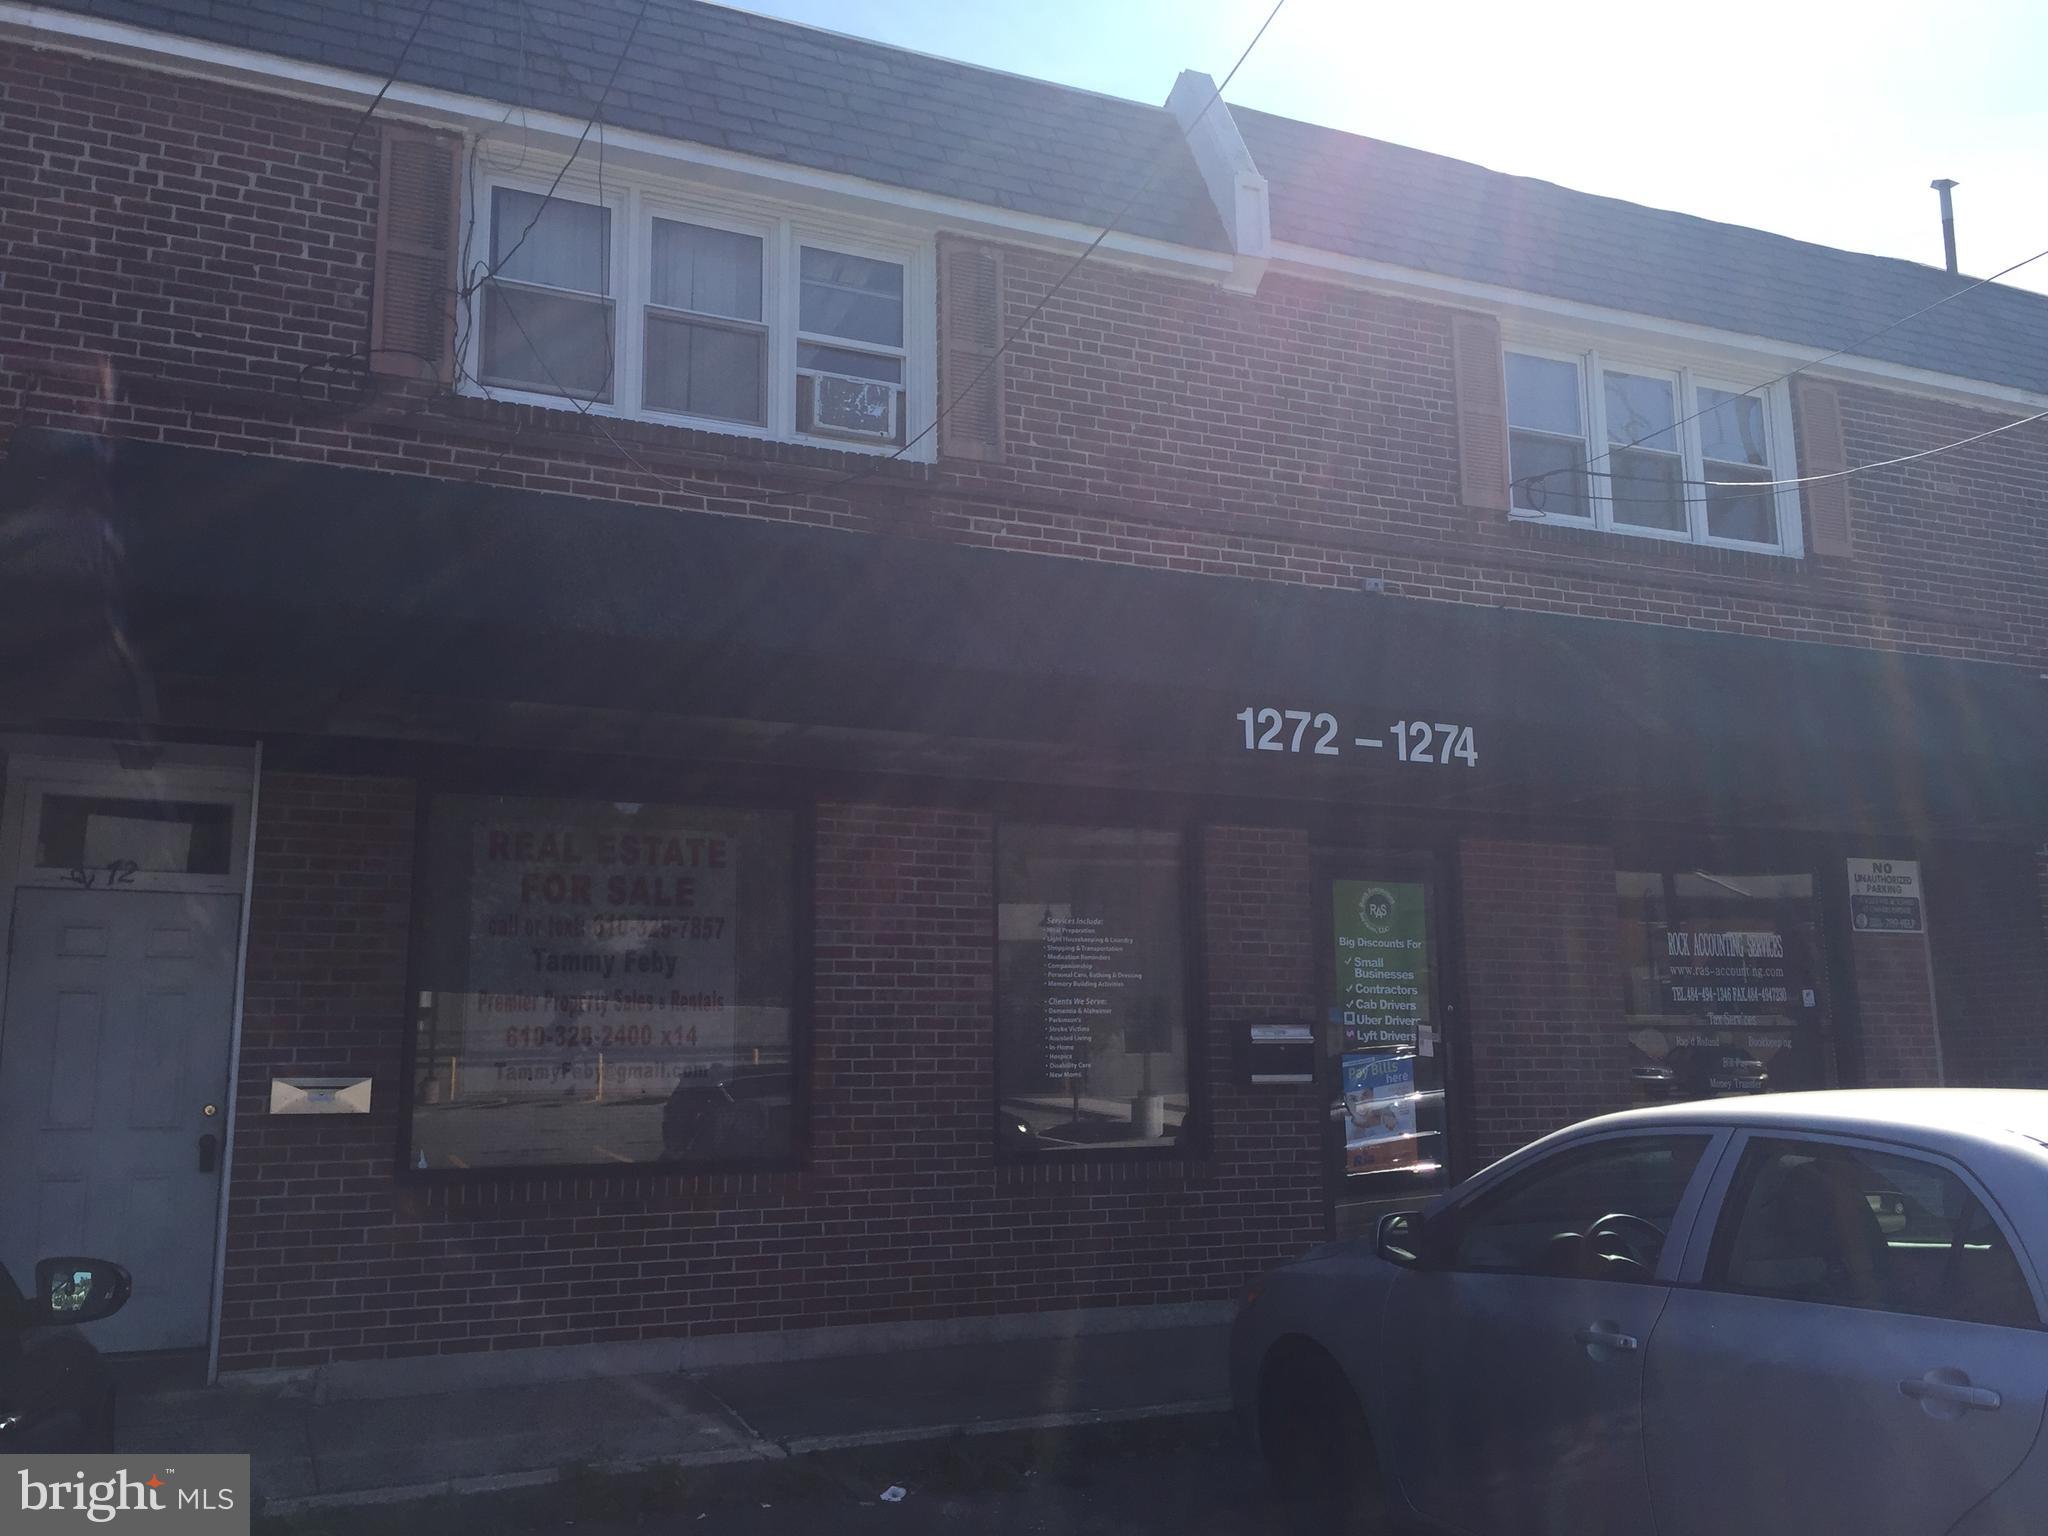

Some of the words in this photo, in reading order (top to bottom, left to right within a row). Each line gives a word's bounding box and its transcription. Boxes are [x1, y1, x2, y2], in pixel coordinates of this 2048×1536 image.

[1237, 707, 1339, 755] 1272
[1390, 720, 1478, 767] 1274
[488, 831, 582, 862] REAL
[598, 835, 727, 868] ESTATE
[1872, 862, 1892, 874] NO
[1854, 873, 1912, 885] UNAUTHORIZED
[522, 874, 592, 904] FOR
[607, 876, 696, 907] SALE
[1866, 884, 1902, 894] PARKING
[1369, 903, 1387, 919] RAS
[489, 913, 518, 937] call
[525, 918, 544, 937] or
[1339, 937, 1355, 949] Big
[1357, 938, 1405, 949] Discounts
[1407, 939, 1422, 949] For
[1667, 931, 1690, 956] ROCK
[1694, 932, 1744, 957] ACCOUNTING
[1748, 933, 1784, 958] SERVICES
[533, 948, 615, 978] Tammy
[624, 949, 678, 978] Feby
[1354, 956, 1384, 968] Small
[1354, 968, 1415, 980] Businesses
[1669, 966, 1784, 979] www.ras-accountng.com
[1355, 983, 1418, 995] Contractors
[478, 989, 537, 1012] Premier
[614, 989, 656, 1011] Sales
[671, 989, 724, 1012] Rentals
[1048, 997, 1072, 1006] Clients
[1074, 997, 1085, 1005] We
[1356, 999, 1377, 1009] Cab
[1380, 1000, 1416, 1010] Drivers
[1356, 1014, 1382, 1025] Uber
[1357, 1030, 1377, 1042] Lyft
[1380, 1030, 1416, 1041] Drivers
[1676, 1035, 1695, 1048] Rapd
[1348, 1067, 1370, 1081] Pay
[1371, 1061, 1399, 1076] Bills
[1386, 1072, 1409, 1083] here
